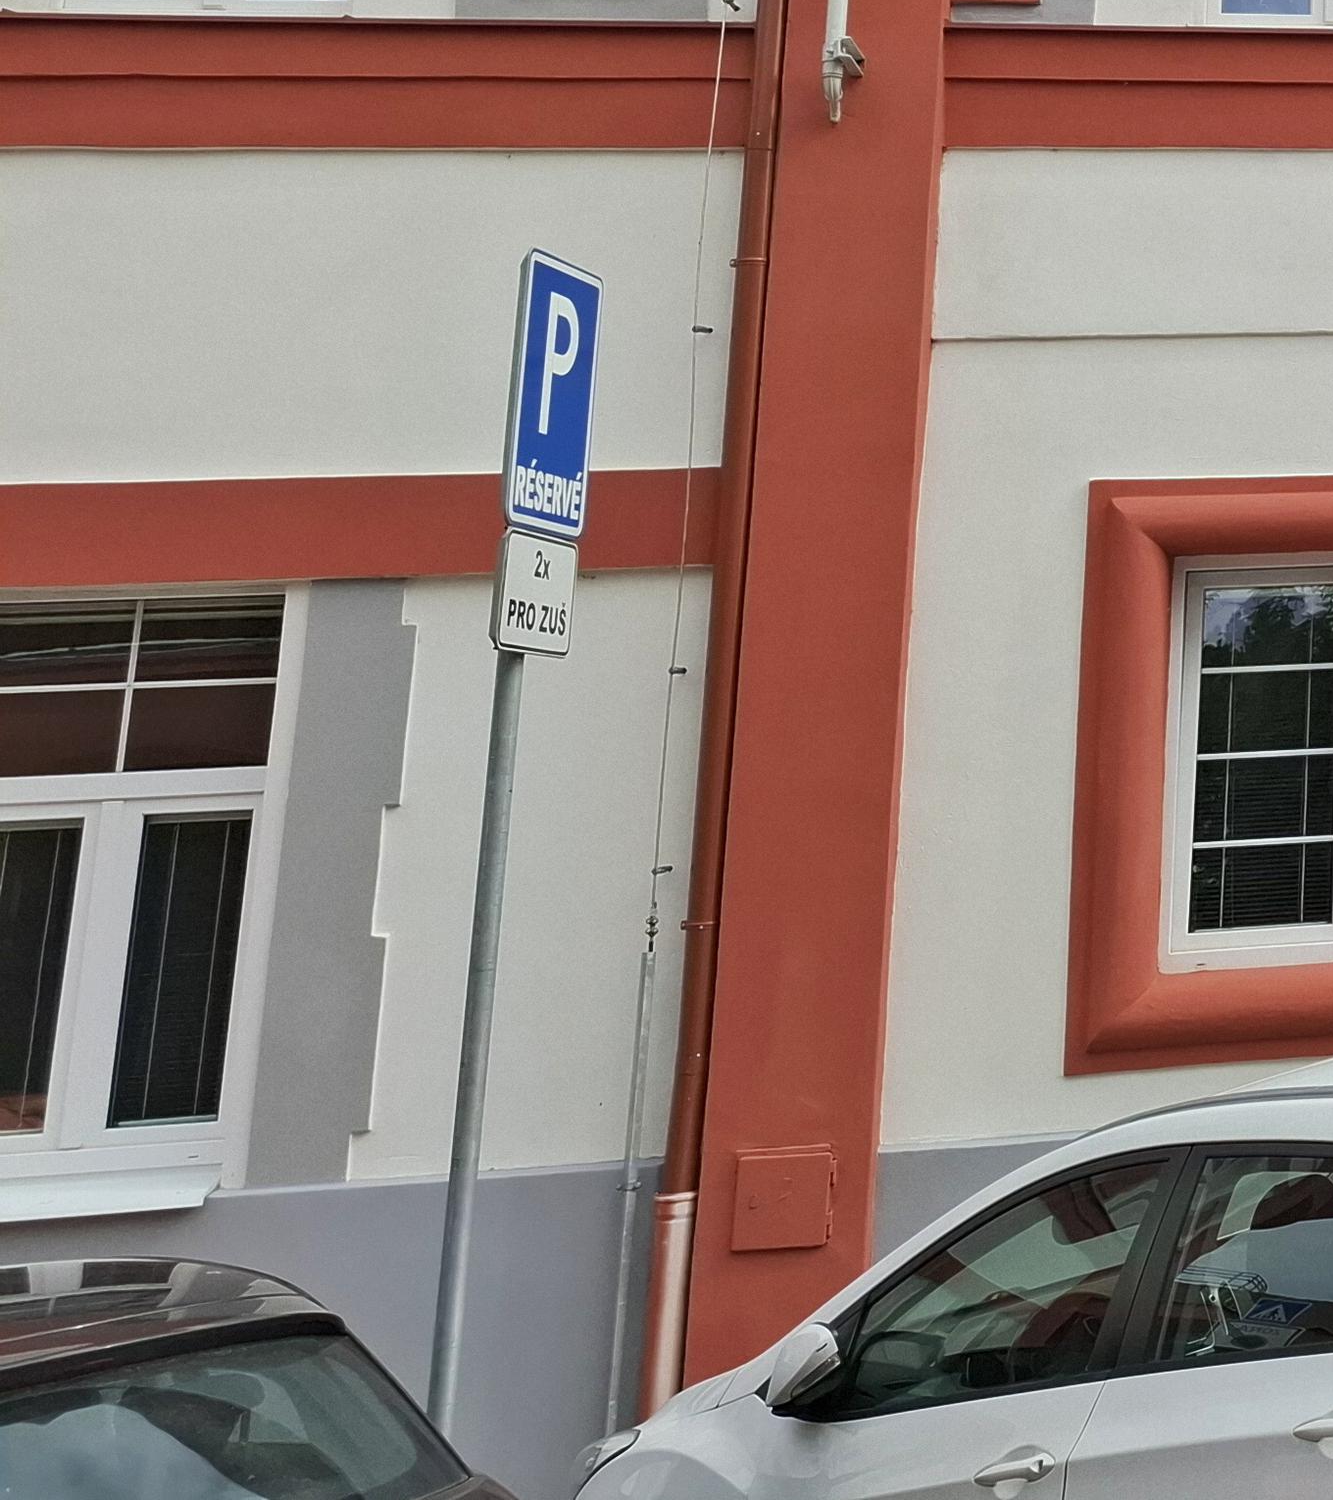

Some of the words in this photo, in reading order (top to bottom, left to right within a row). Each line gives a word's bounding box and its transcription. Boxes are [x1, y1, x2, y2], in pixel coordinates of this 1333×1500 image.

[538, 291, 579, 435] P
[513, 458, 583, 521] RÉSERVÉ
[534, 550, 551, 580] 2x
[507, 599, 536, 631] PRO
[539, 602, 567, 636] ZUŠ
